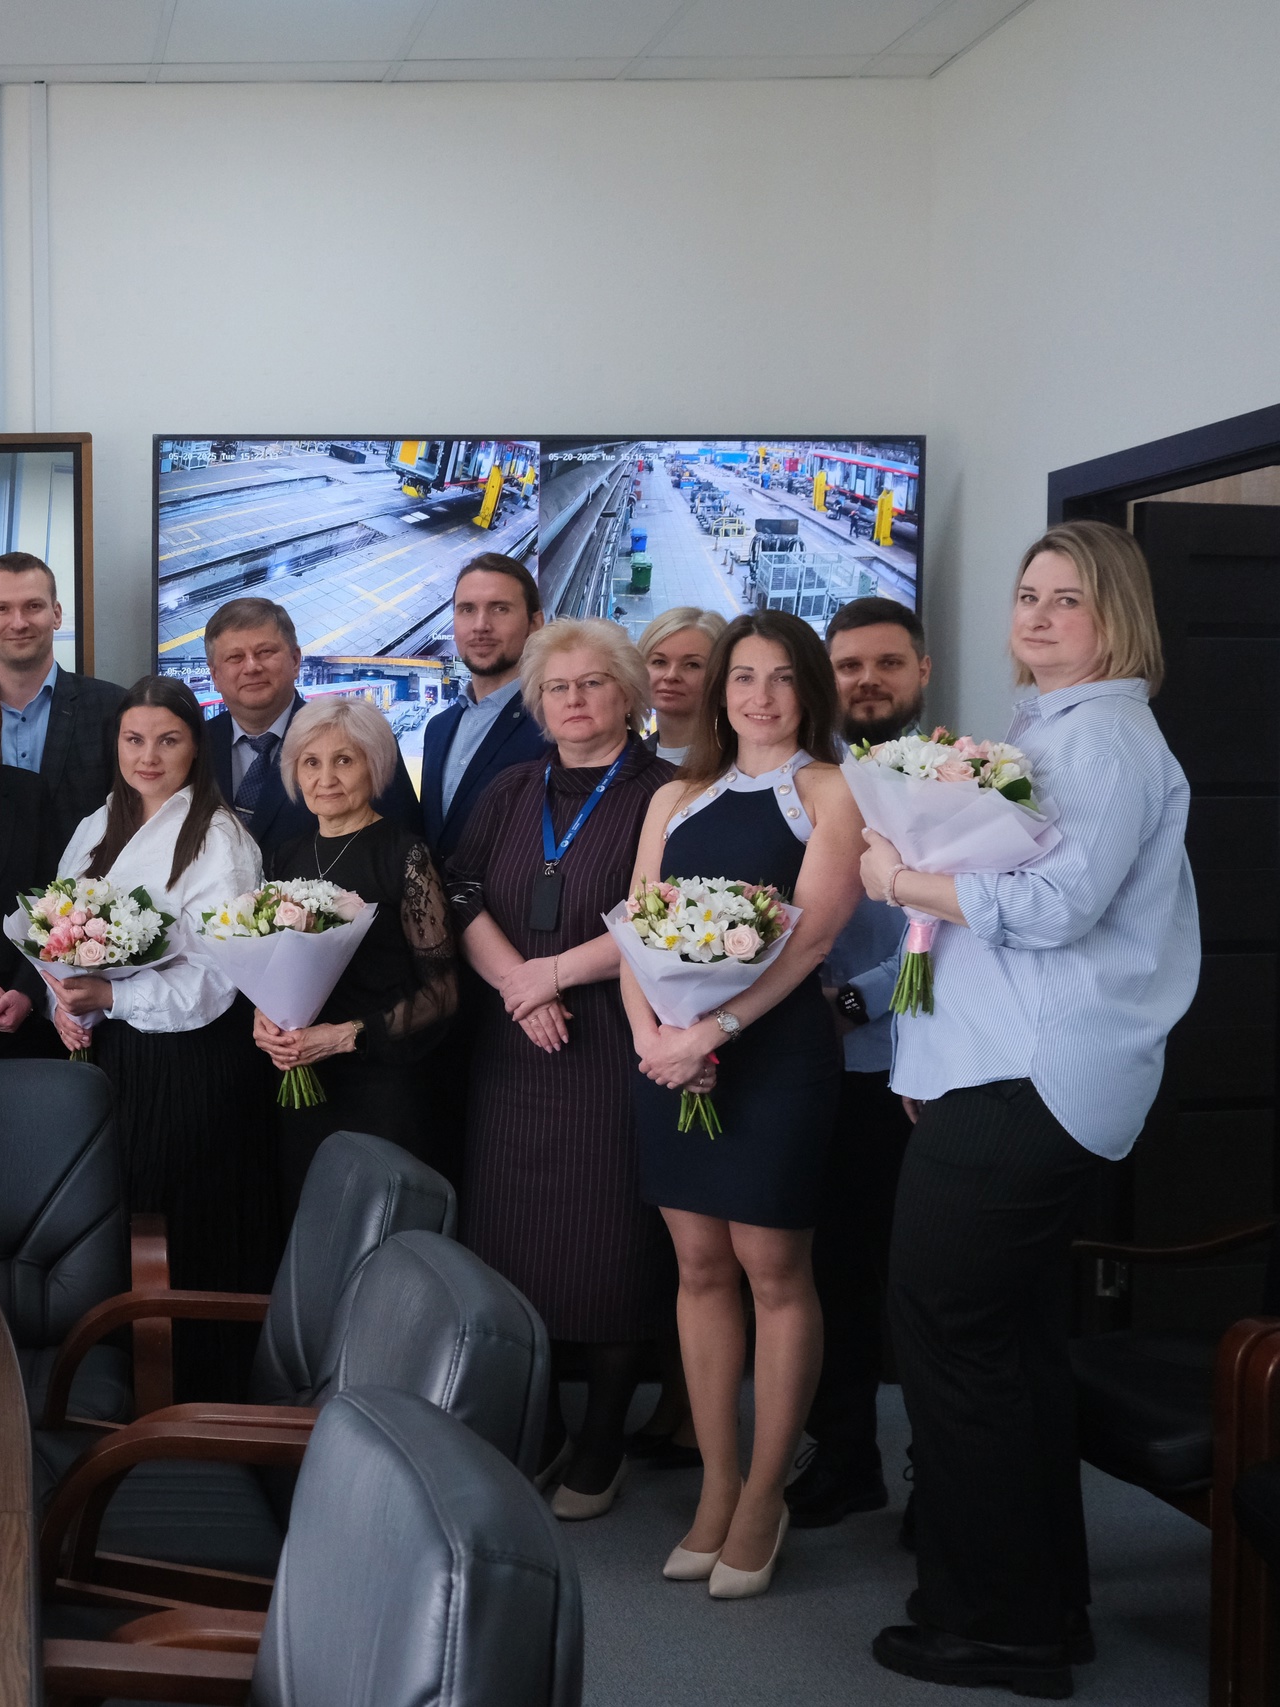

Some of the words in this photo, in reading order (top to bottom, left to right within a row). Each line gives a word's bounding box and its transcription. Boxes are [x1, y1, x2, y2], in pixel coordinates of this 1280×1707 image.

[168, 452, 217, 460] 05-20-2025
[221, 452, 236, 460] Tue
[548, 453, 597, 461] 05-20-2025
[601, 452, 616, 461] Tue
[167, 667, 210, 675] 05-20-202
